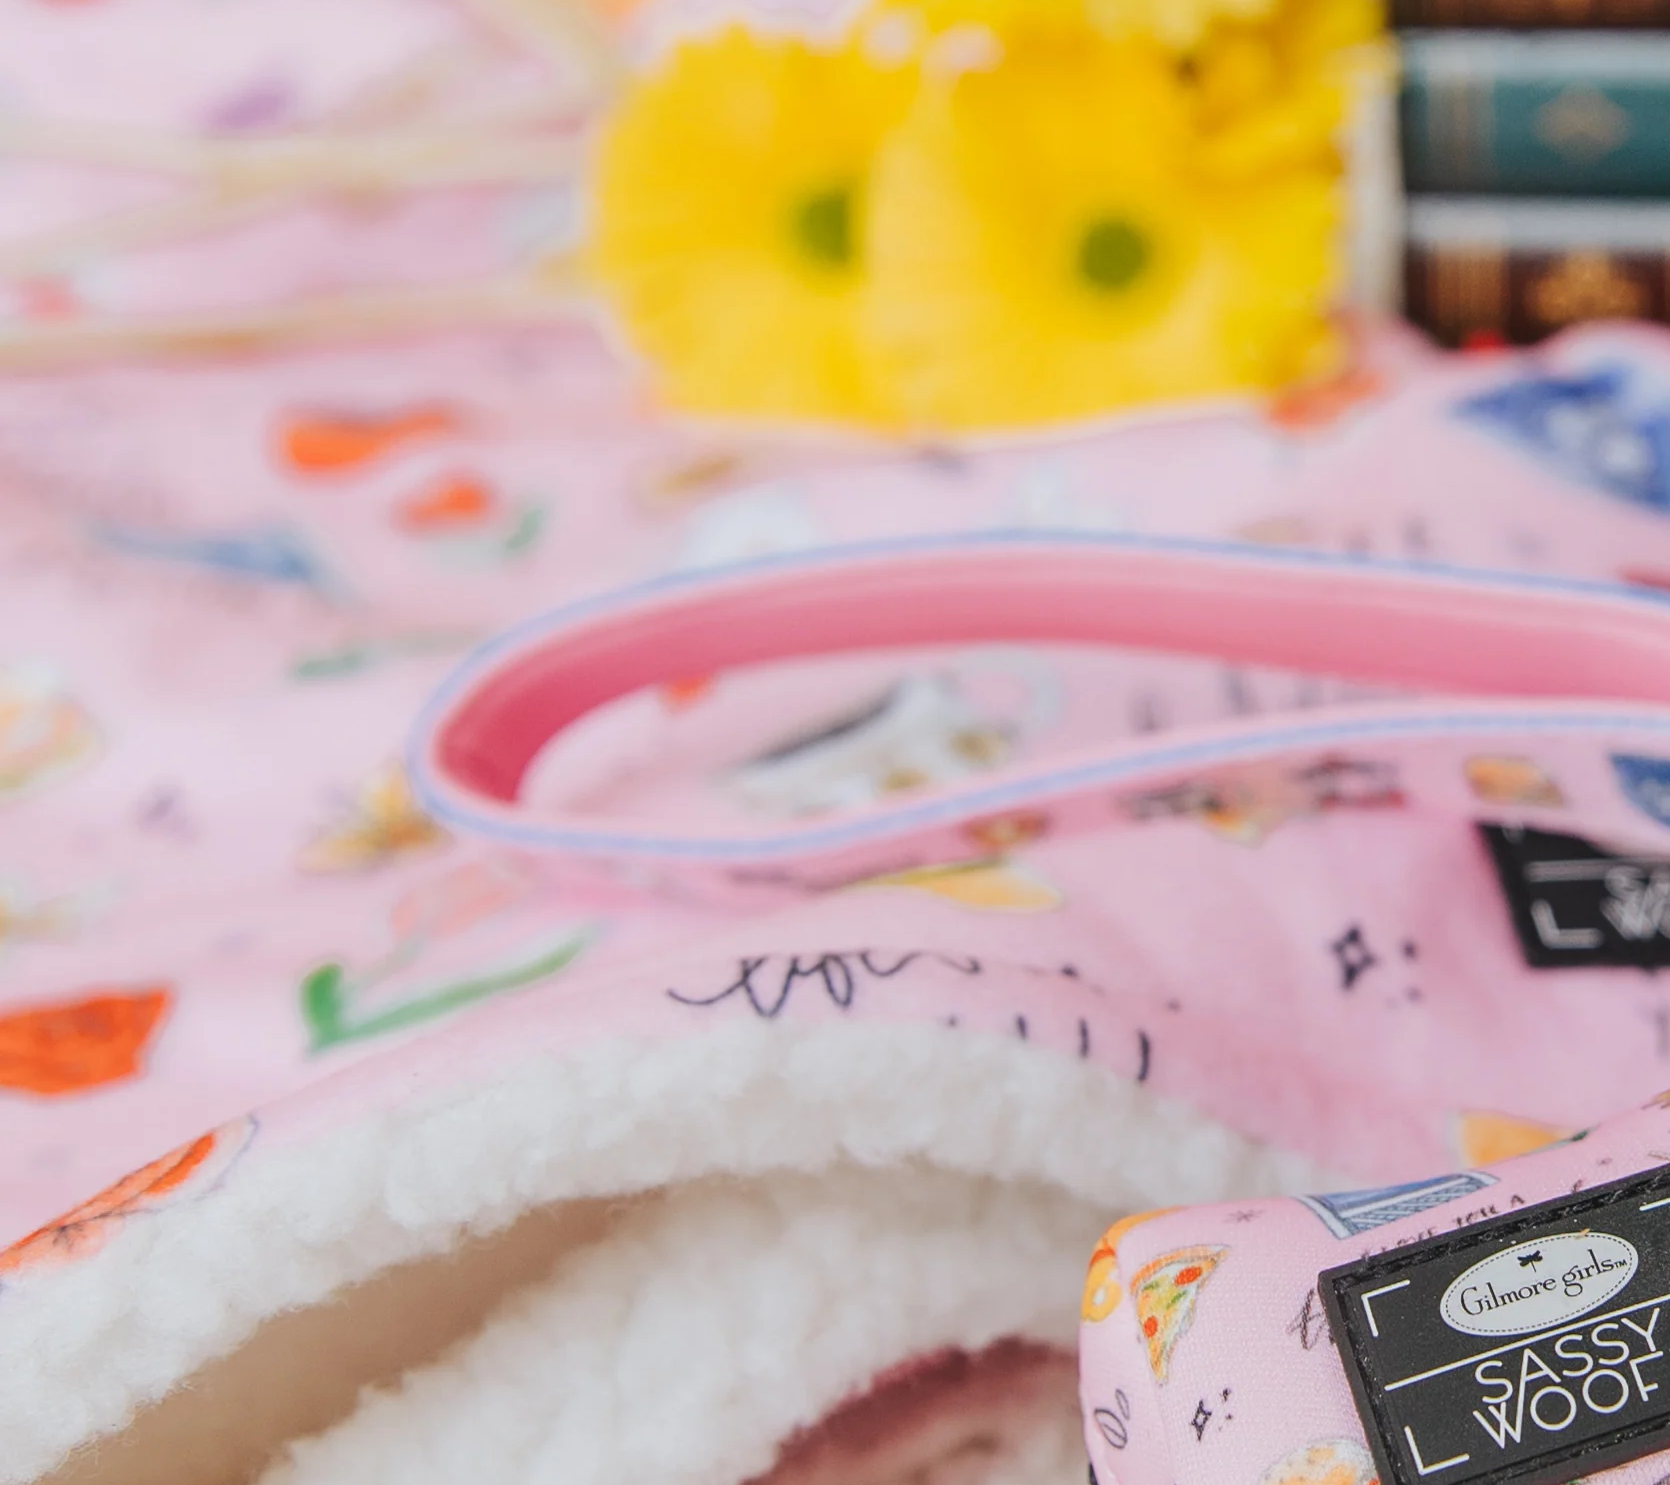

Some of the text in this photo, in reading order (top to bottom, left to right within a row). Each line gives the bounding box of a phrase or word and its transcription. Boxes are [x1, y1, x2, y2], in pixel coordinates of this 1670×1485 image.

[1459, 1272, 1557, 1317] Gilmore
[1472, 1351, 1664, 1449] WOOF
[1475, 1308, 1661, 1404] SASSY
